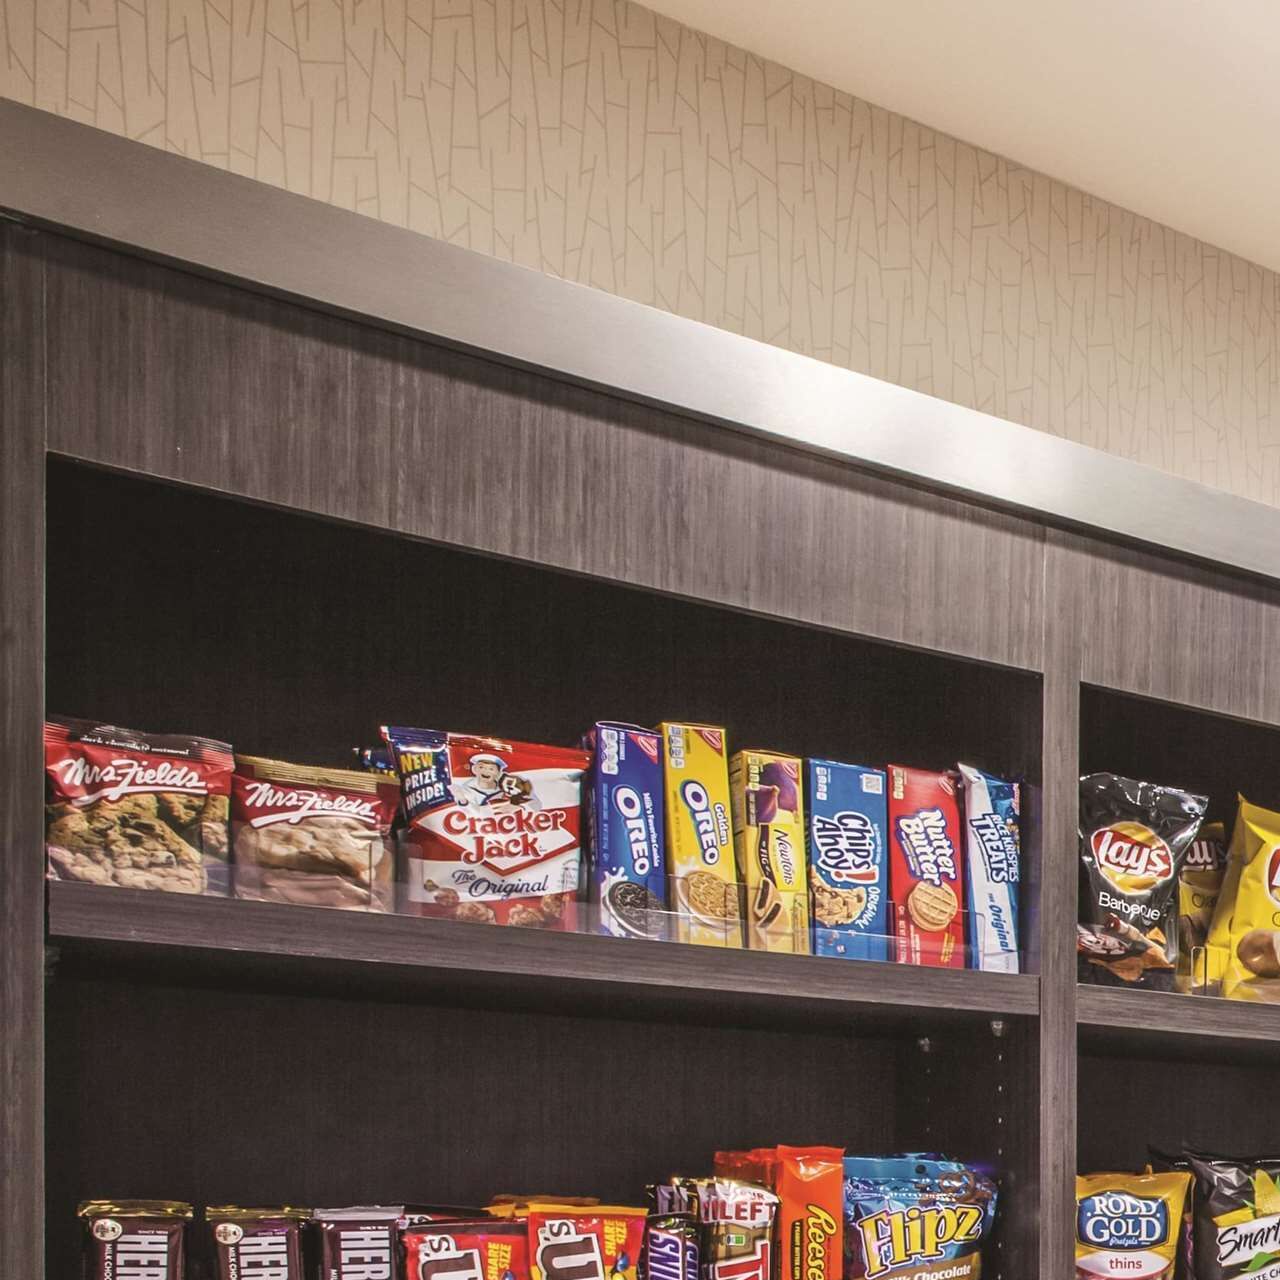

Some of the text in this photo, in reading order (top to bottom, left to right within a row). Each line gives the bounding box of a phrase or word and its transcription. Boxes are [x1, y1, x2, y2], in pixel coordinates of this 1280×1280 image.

[400, 752, 432, 773] NEW
[405, 770, 437, 789] PRIZE
[406, 783, 444, 810] INSIDE!
[443, 809, 566, 835] Cracker
[612, 785, 650, 876] OREO
[647, 813, 657, 842] Favorite
[681, 780, 719, 865] OREO
[714, 802, 729, 845] Golden
[462, 832, 542, 864] Jack
[836, 812, 872, 871] Chips
[899, 816, 943, 887] Butter
[919, 808, 957, 880] Nutter
[969, 812, 1009, 884] TREATS
[990, 813, 1019, 883] RICE KRISPIES
[1100, 831, 1170, 877] Lay's
[760, 846, 768, 868] FIG
[774, 828, 793, 885] Newtons
[452, 869, 476, 884] The
[469, 874, 548, 899] Original
[855, 886, 881, 929] ORIGINAL
[988, 904, 1013, 953] Original
[720, 1201, 776, 1221] LEFT
[1094, 1193, 1159, 1217] ROLD
[603, 1219, 617, 1256] SHARE
[614, 1220, 628, 1246] SIZE
[858, 1205, 982, 1279] Flipz
[1087, 1216, 1162, 1242] GOLD
[103, 1244, 112, 1260] MILK
[228, 1246, 238, 1263] MILK
[498, 1243, 512, 1270] SIZE
[1109, 1257, 1142, 1270] thins
